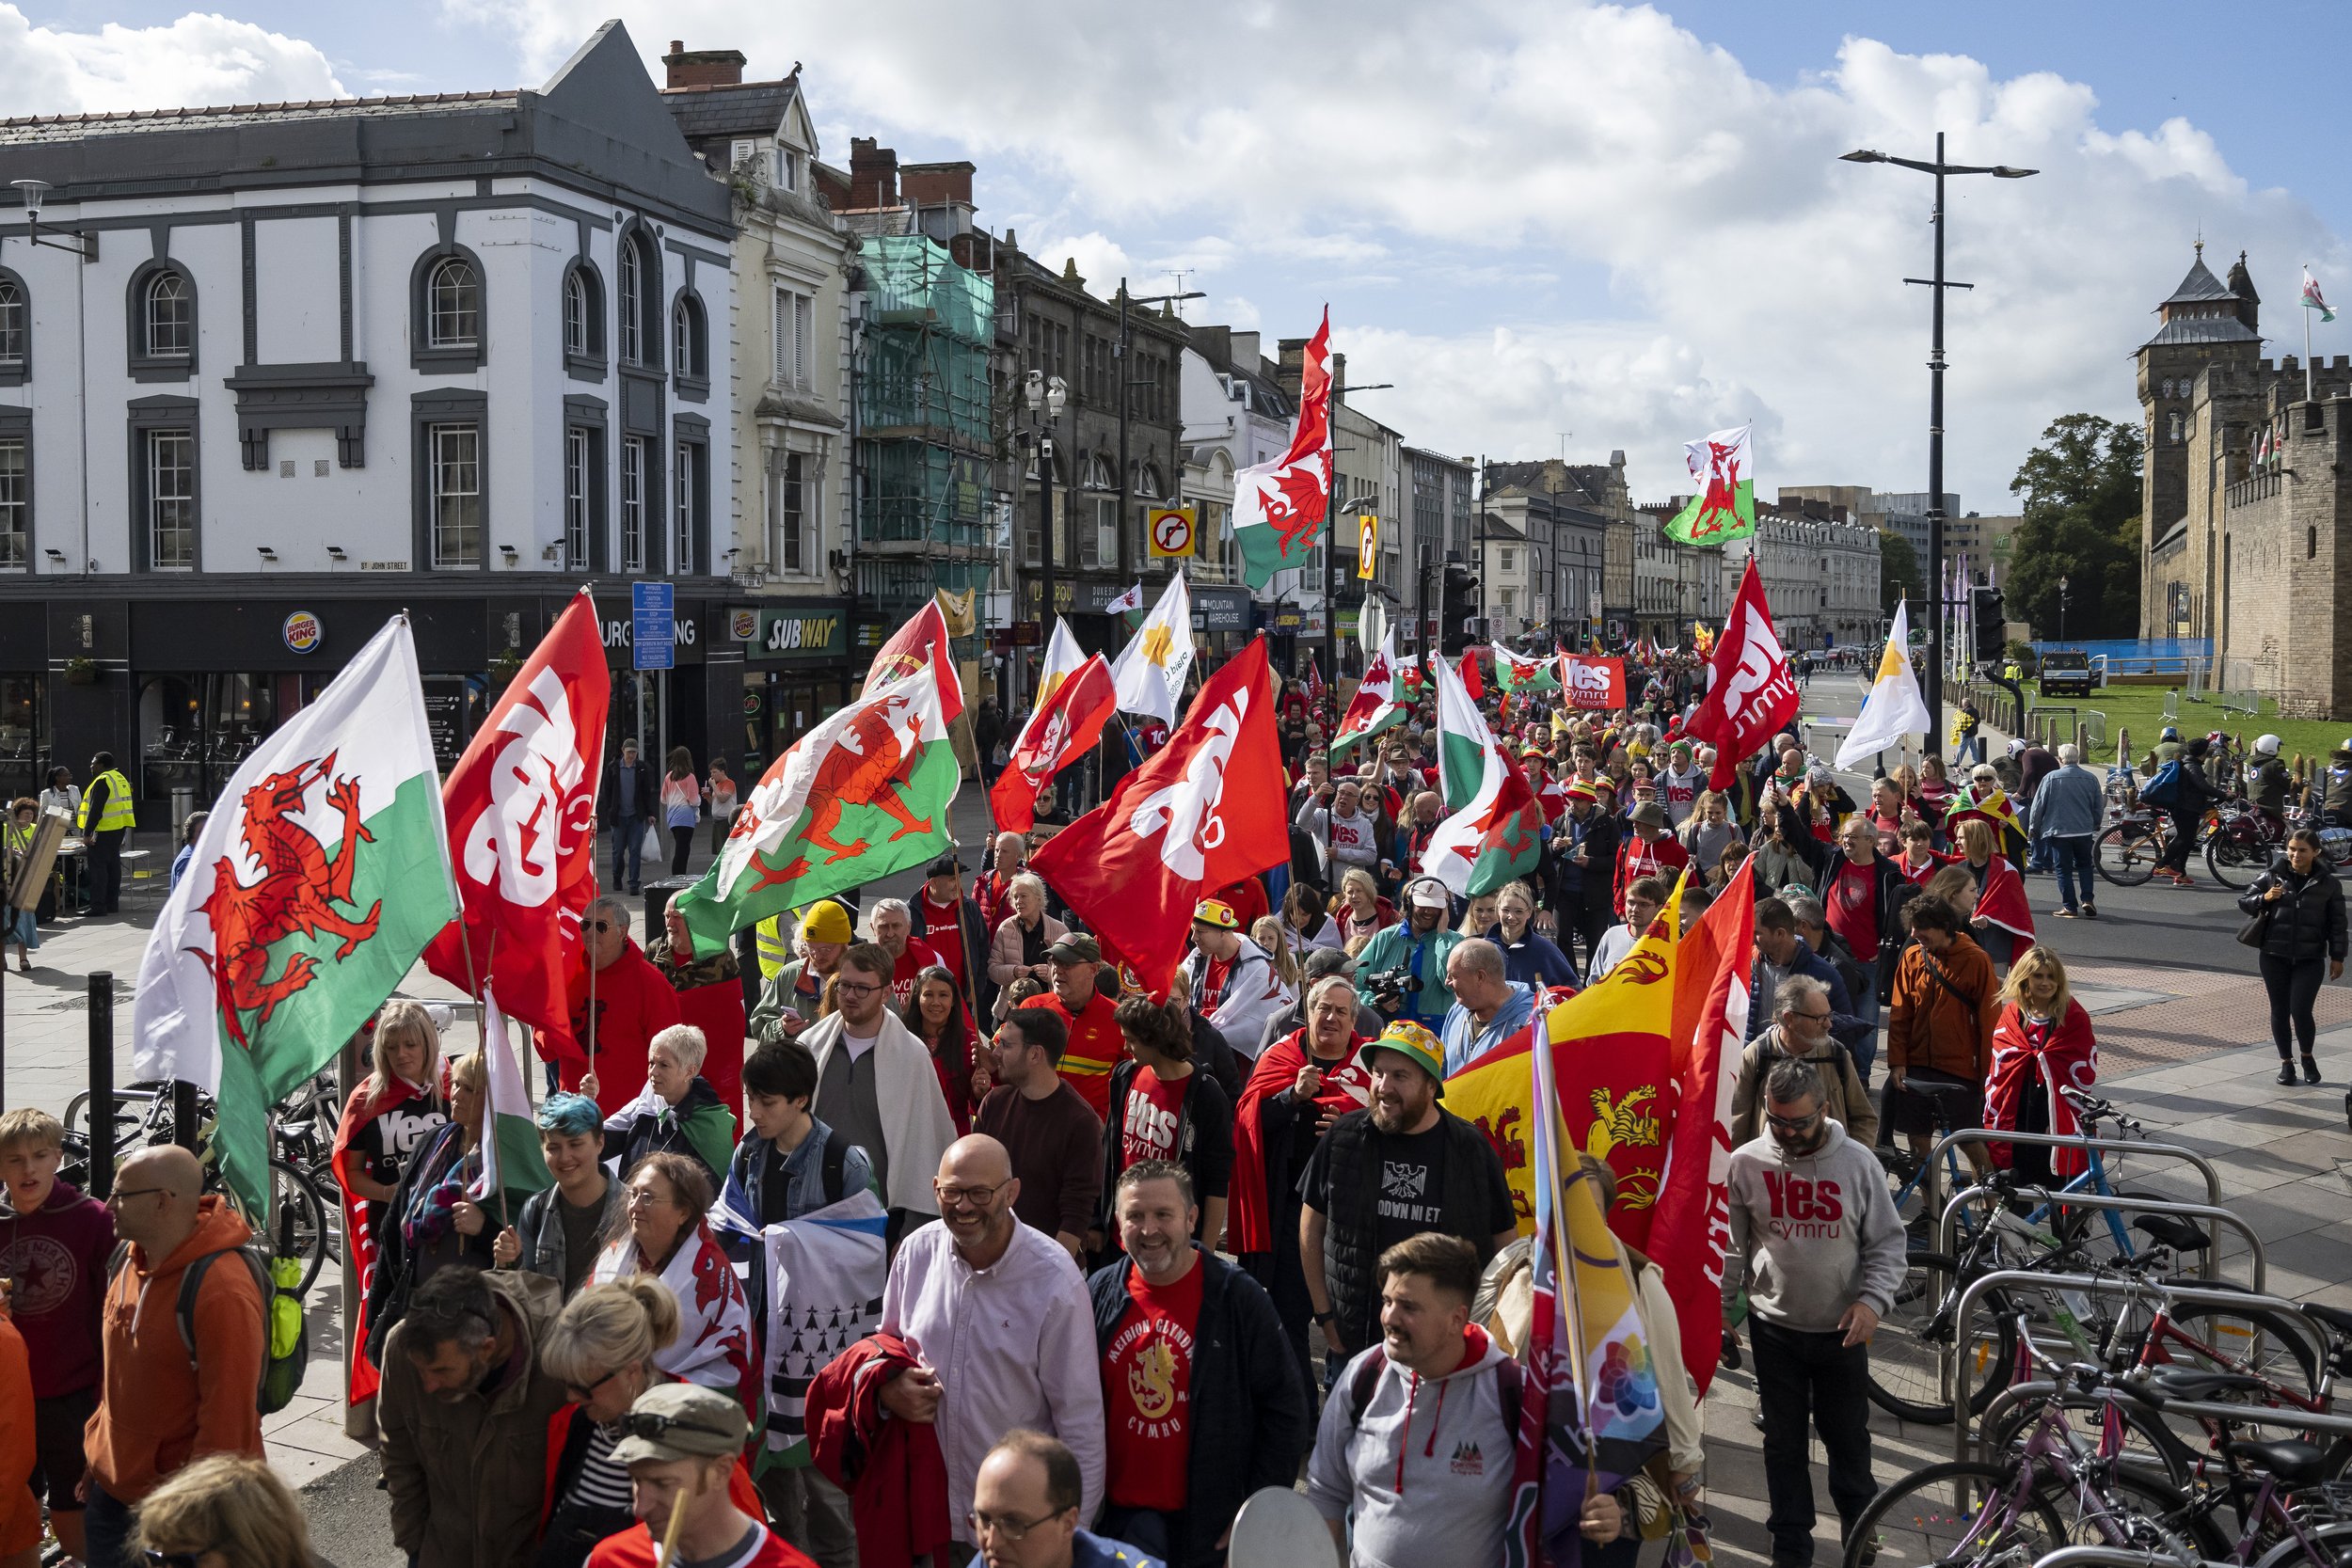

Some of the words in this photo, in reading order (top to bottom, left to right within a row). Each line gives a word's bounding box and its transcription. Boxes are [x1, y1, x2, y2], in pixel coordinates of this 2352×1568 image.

[372, 562, 386, 570] JOHN
[387, 562, 406, 570] STREET
[1208, 600, 1234, 610] MOUNTAIN
[287, 619, 315, 633] BURGER
[735, 617, 754, 626] BURGER
[1209, 612, 1239, 623] WAREHOUSE
[289, 626, 316, 644] KING
[599, 621, 631, 647] URG
[674, 619, 695, 645] NG
[736, 623, 755, 633] KING
[768, 615, 837, 651] SUBWAY
[1564, 657, 1611, 690] Yes
[1565, 688, 1609, 702] cymru
[1576, 697, 1609, 706] Penarth
[1151, 730, 1166, 745] 10
[1667, 785, 1693, 802] Yes
[1124, 1088, 1178, 1149] Yes
[1121, 1134, 1168, 1163] cymru
[1761, 1170, 1843, 1222] Yes
[1411, 1204, 1423, 1222] NI
[1769, 1220, 1840, 1241] cymru
[1108, 1319, 1151, 1364] MEIBION
[1155, 1318, 1196, 1370] GLYNDW
[1127, 1416, 1182, 1438] CYMRU
